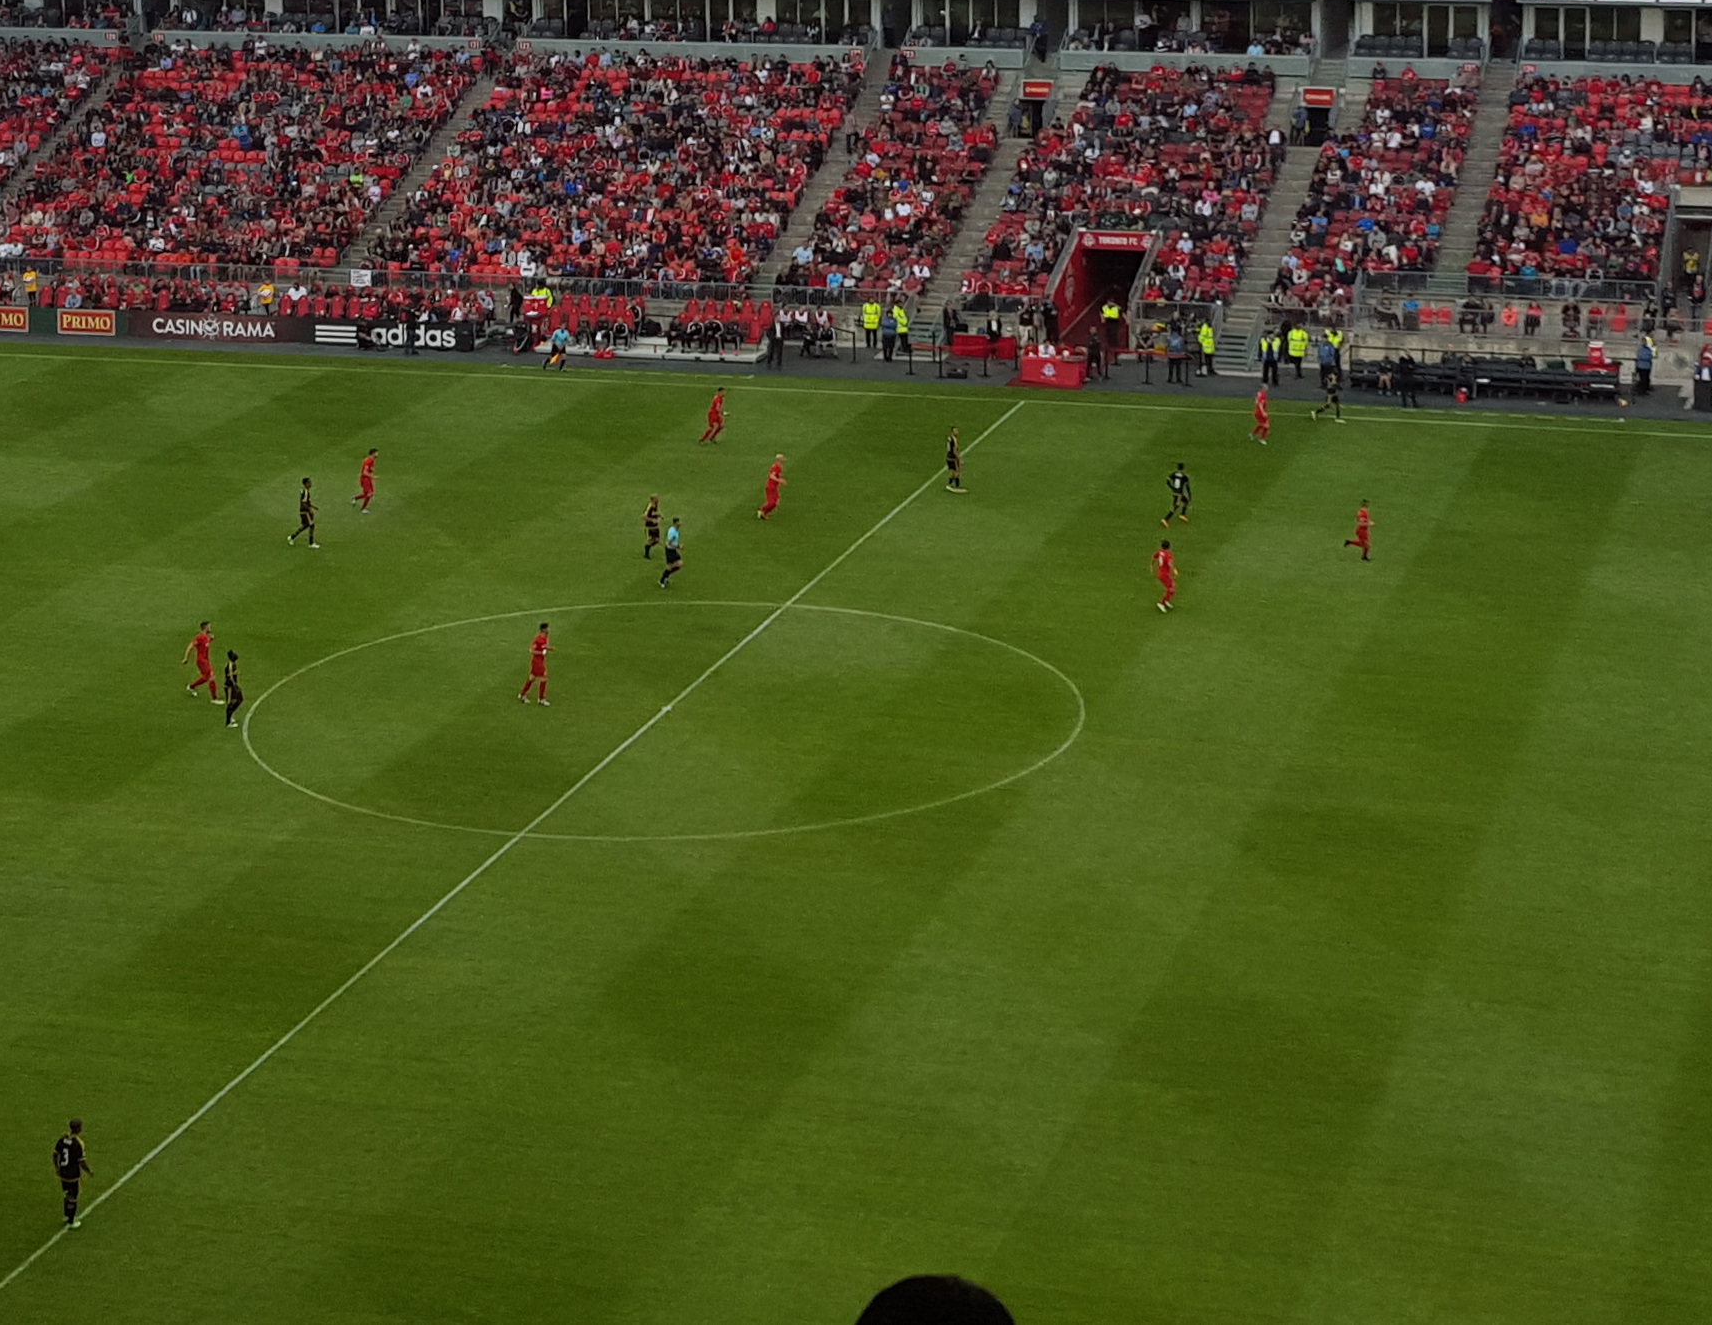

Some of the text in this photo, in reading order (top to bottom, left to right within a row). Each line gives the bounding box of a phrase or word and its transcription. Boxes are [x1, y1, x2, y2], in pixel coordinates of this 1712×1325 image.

[62, 312, 111, 330] PRIMO
[222, 321, 275, 337] RAMA
[61, 1147, 70, 1166] 3
